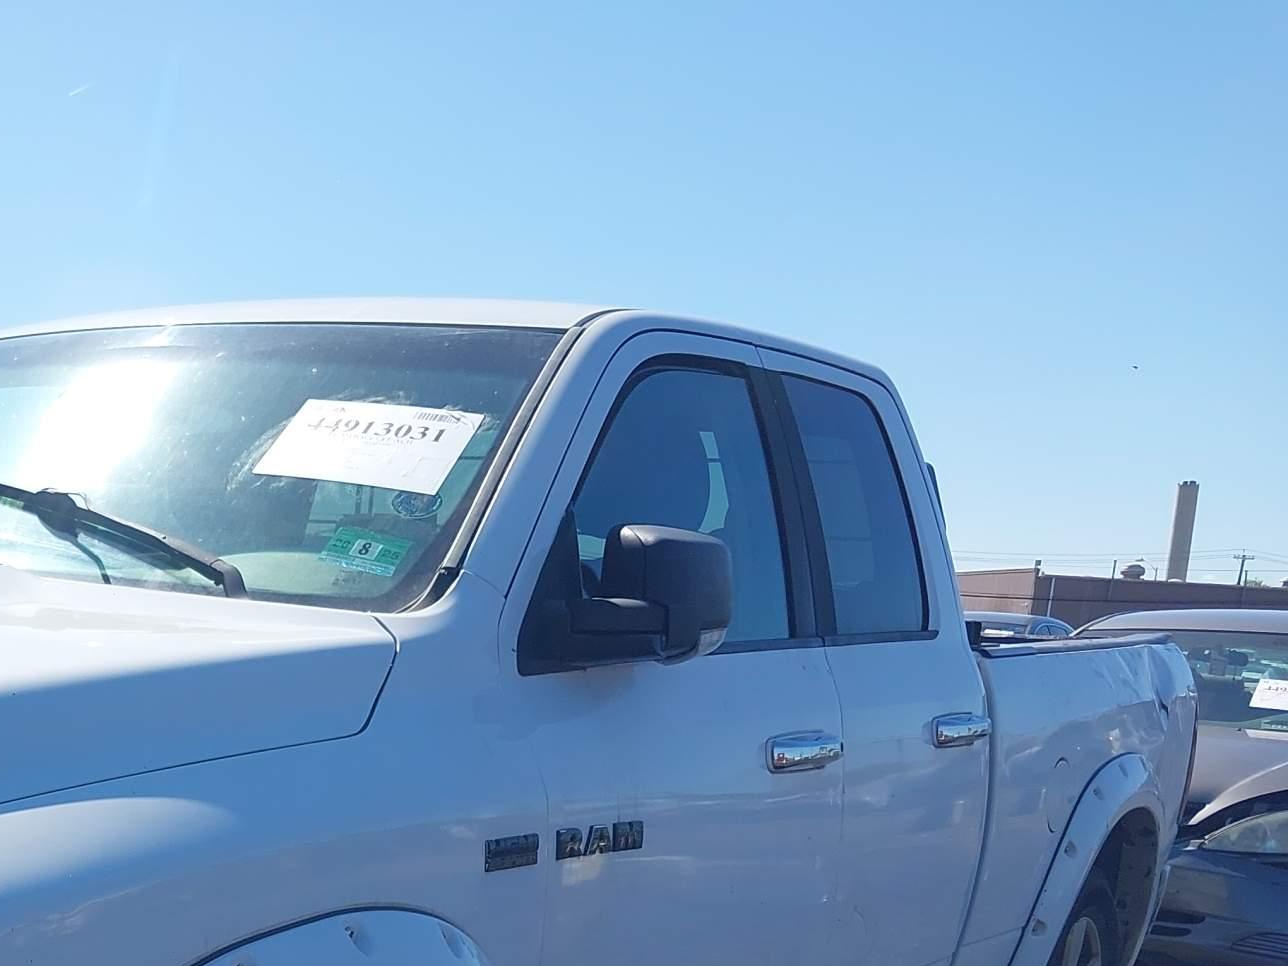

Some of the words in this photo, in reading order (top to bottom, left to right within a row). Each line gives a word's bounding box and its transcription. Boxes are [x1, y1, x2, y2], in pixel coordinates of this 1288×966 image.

[307, 418, 448, 443] 44913031
[358, 542, 372, 556] 8
[556, 820, 643, 861] RAM
